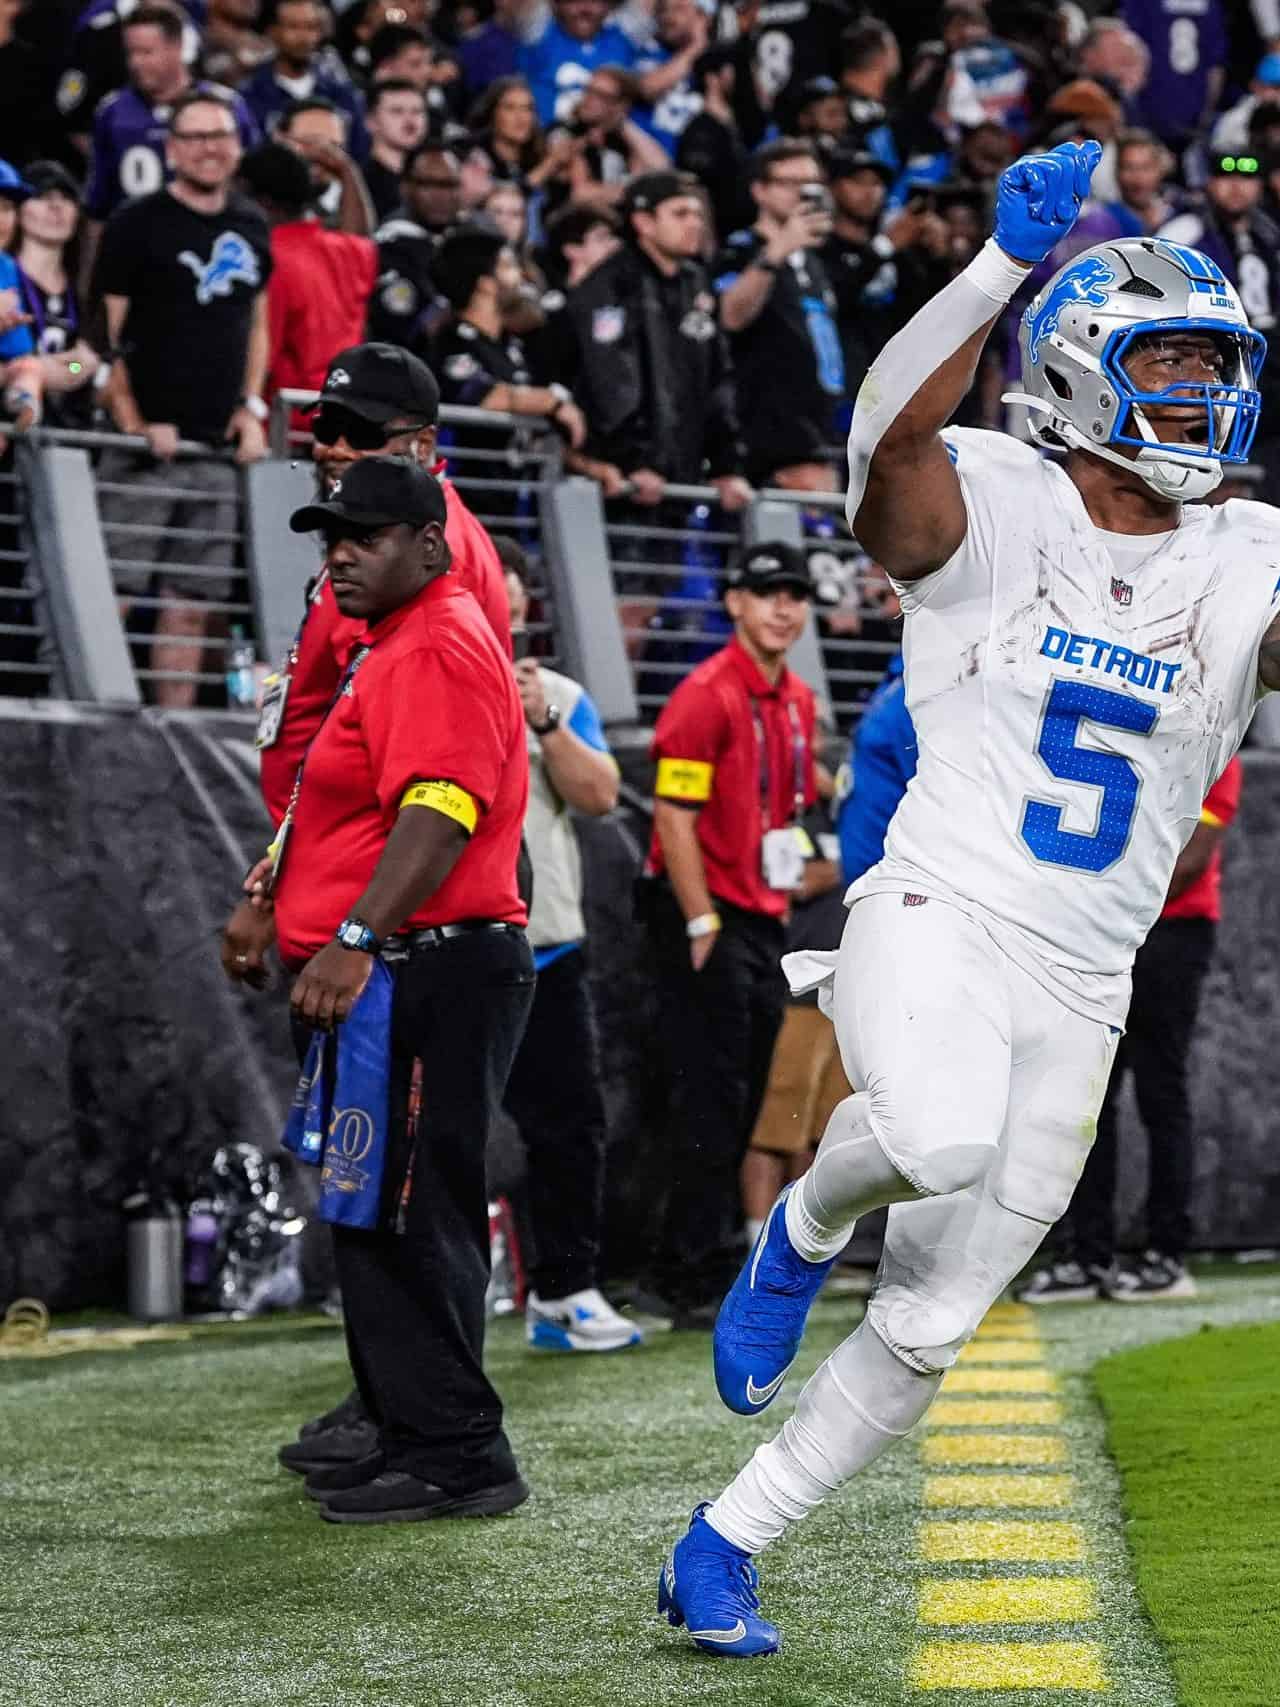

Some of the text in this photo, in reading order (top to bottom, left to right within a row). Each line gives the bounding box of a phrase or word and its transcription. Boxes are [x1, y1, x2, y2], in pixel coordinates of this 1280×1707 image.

[120, 145, 161, 197] 0
[1040, 625, 1182, 693] DETROIT
[1017, 673, 1161, 878] 5
